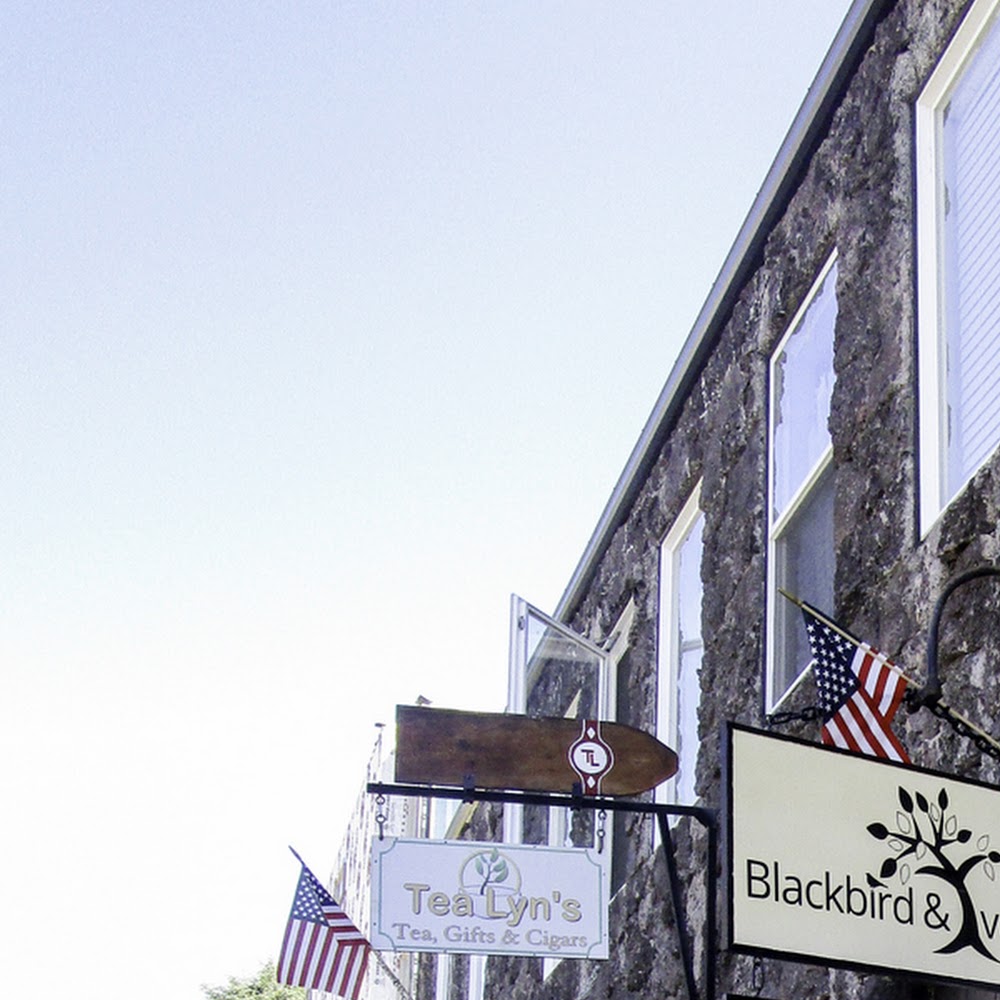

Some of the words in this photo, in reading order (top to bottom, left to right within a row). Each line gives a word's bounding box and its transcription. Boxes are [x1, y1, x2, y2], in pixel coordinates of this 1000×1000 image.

[404, 882, 475, 917] Tea
[485, 886, 583, 926] Lyn's
[746, 858, 914, 926] Blackbird
[924, 892, 951, 931] &
[392, 922, 437, 943] Tea,
[443, 925, 495, 945] Gifts
[502, 928, 520, 945] &
[525, 928, 588, 951] Cigars
